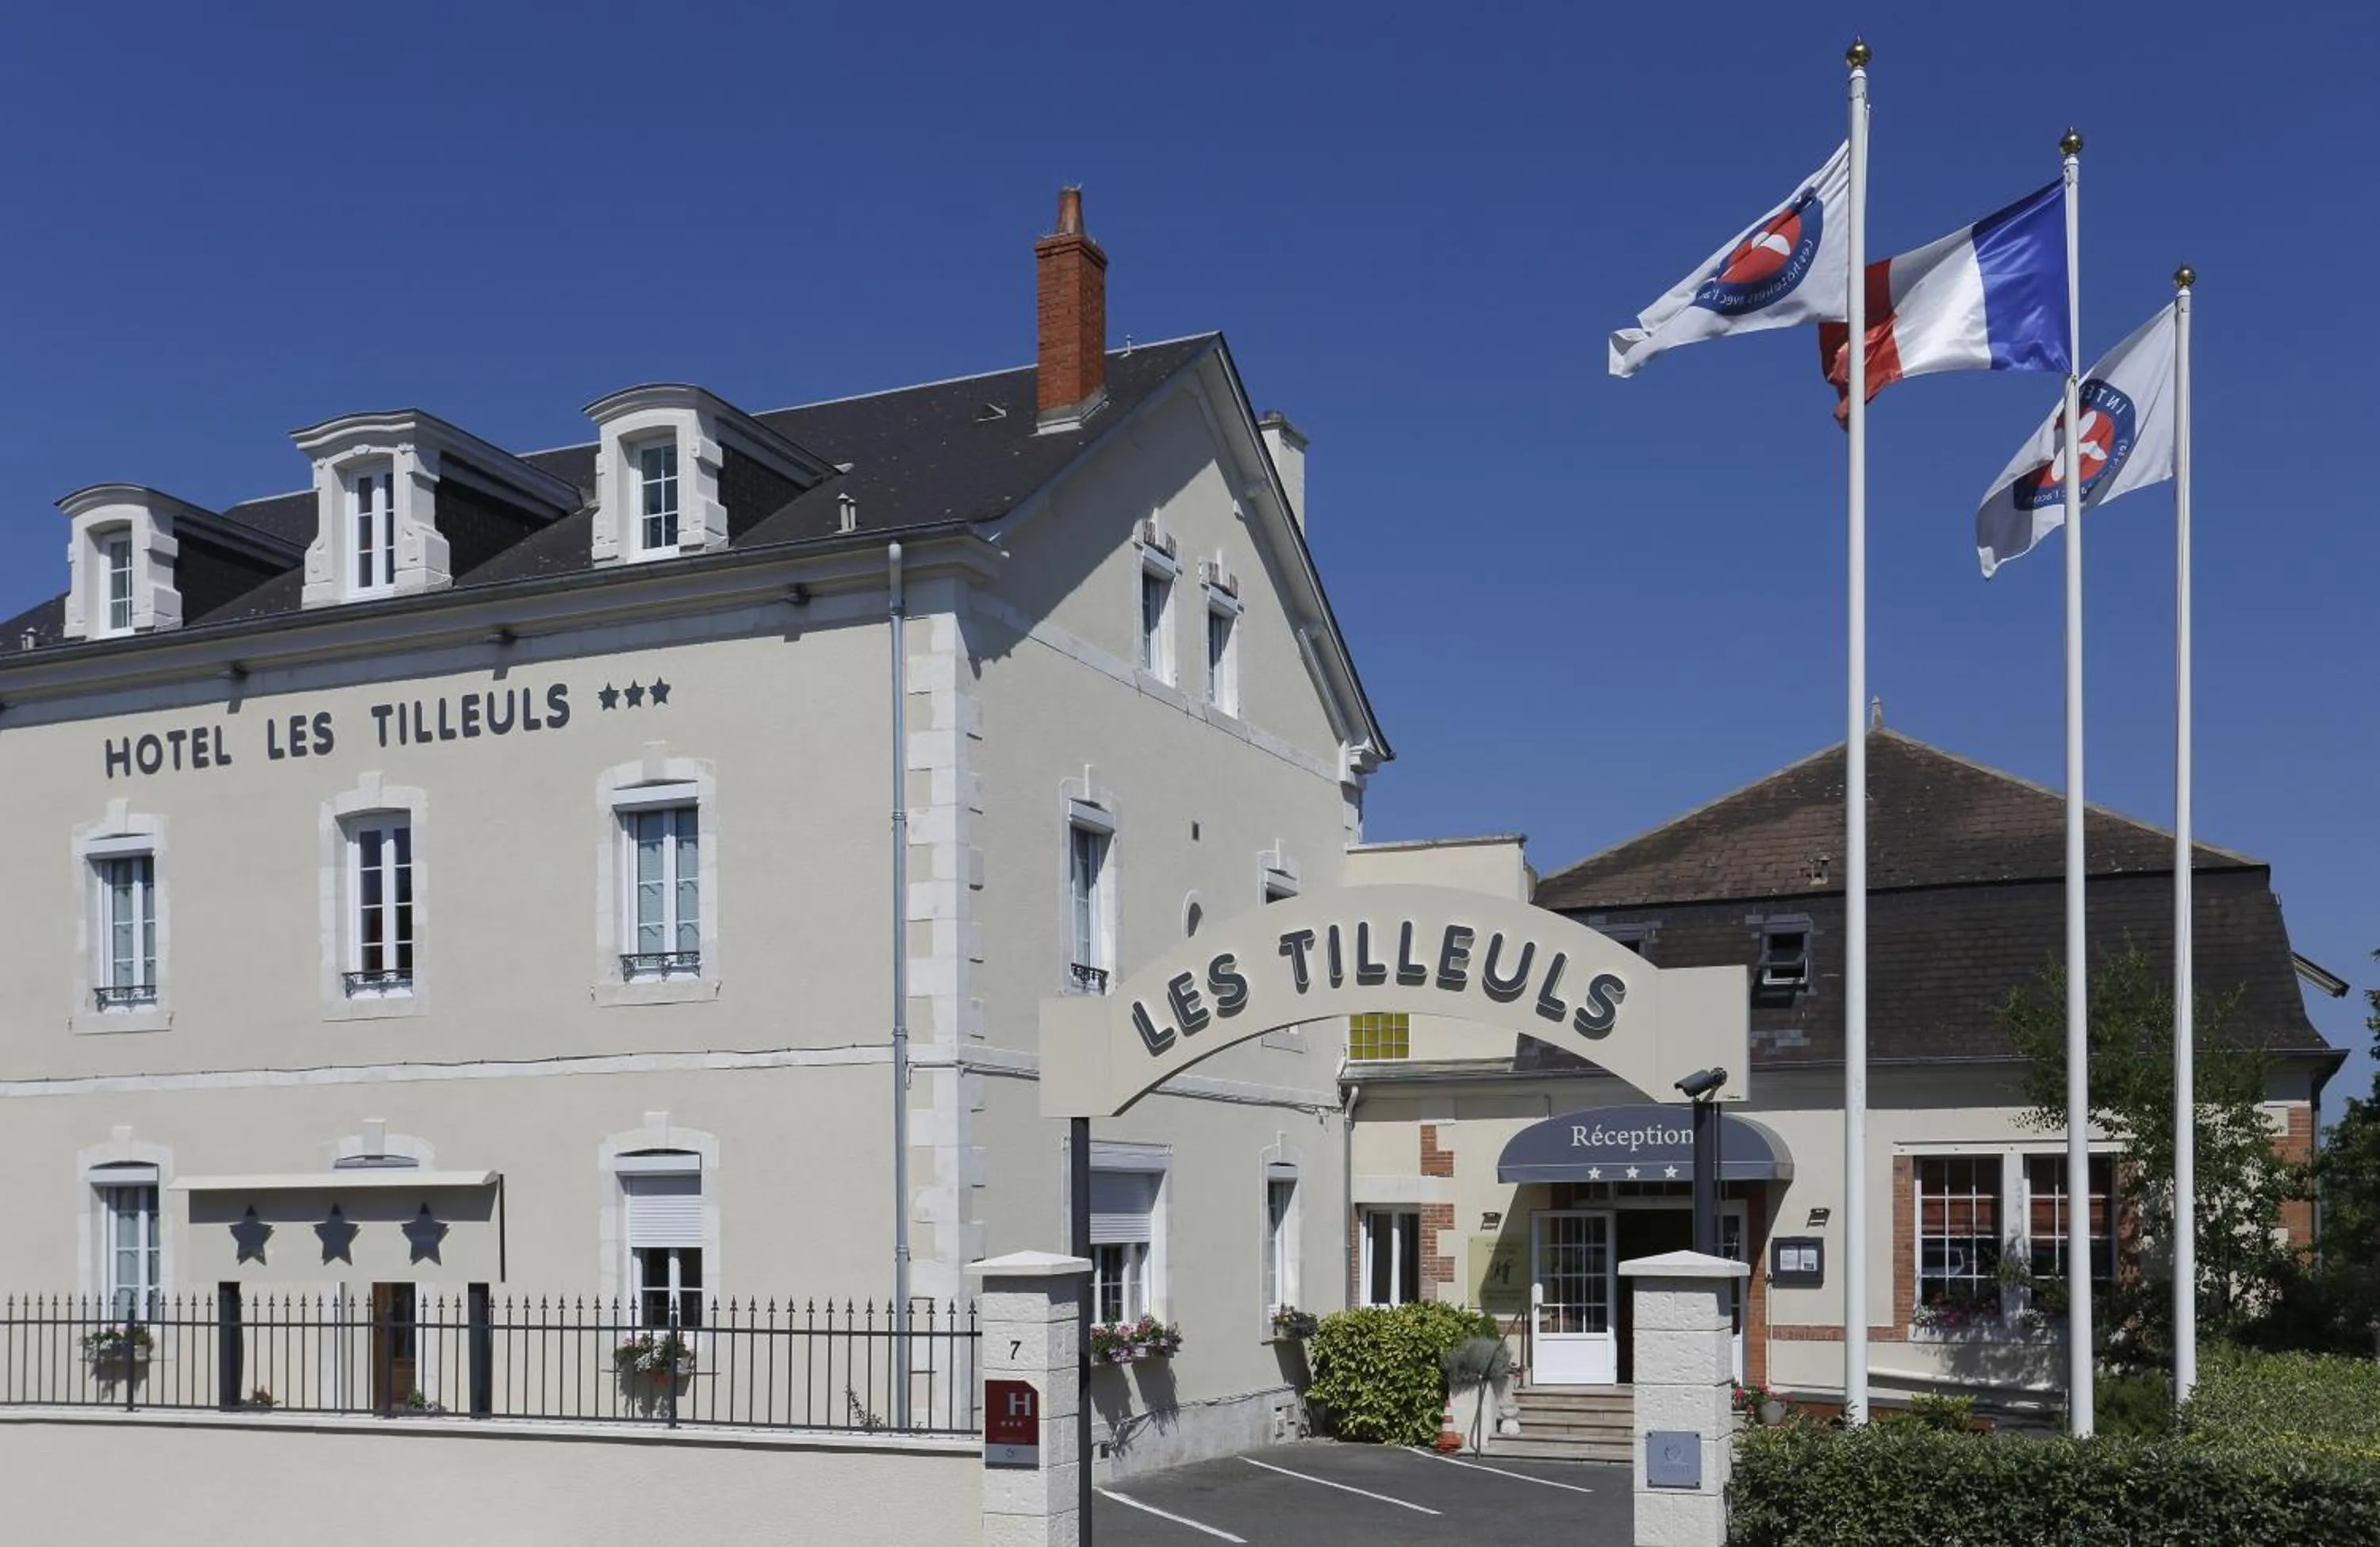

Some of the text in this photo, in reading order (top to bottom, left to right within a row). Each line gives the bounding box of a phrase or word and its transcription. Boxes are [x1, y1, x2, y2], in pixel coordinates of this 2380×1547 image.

[105, 683, 571, 779] HOTEL LES TILLEULS
[1132, 920, 1626, 1058] LES TILLEULS
[1570, 1124, 1694, 1152] Réception
[1010, 1341, 1022, 1360] 7
[1009, 1392, 1031, 1416] H
